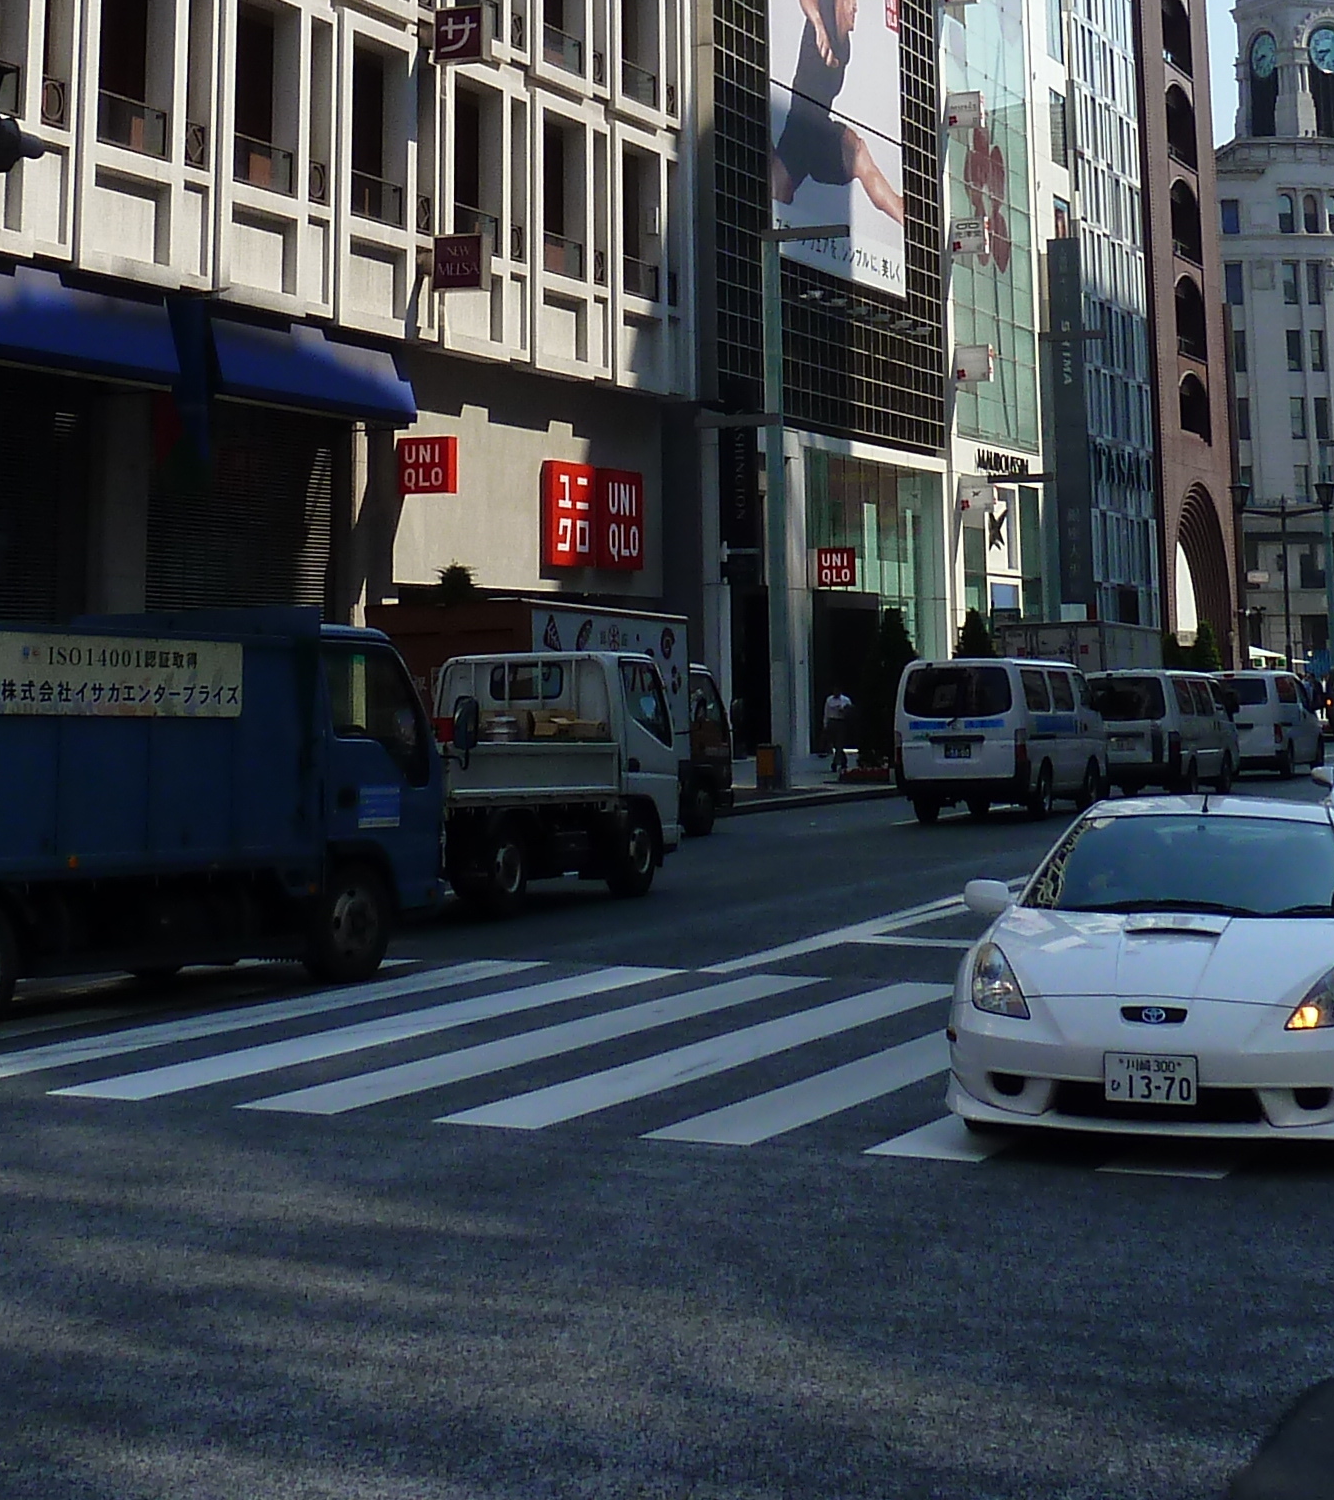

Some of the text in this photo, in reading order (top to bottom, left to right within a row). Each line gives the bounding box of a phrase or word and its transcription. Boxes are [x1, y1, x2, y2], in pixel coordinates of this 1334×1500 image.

[436, 258, 481, 277] MELSA
[403, 446, 441, 463] UNI
[403, 468, 445, 491] QLO
[558, 474, 590, 511] ユニ
[608, 480, 637, 516] UNI
[557, 516, 590, 554] クロ
[608, 525, 640, 562] QLO
[821, 552, 849, 568] UNI
[821, 568, 851, 584] QLO
[1, 678, 239, 705] 株式会社イサカエンタープライズ
[1153, 1059, 1175, 1073] 300
[1129, 1074, 1191, 1102] 13-70
